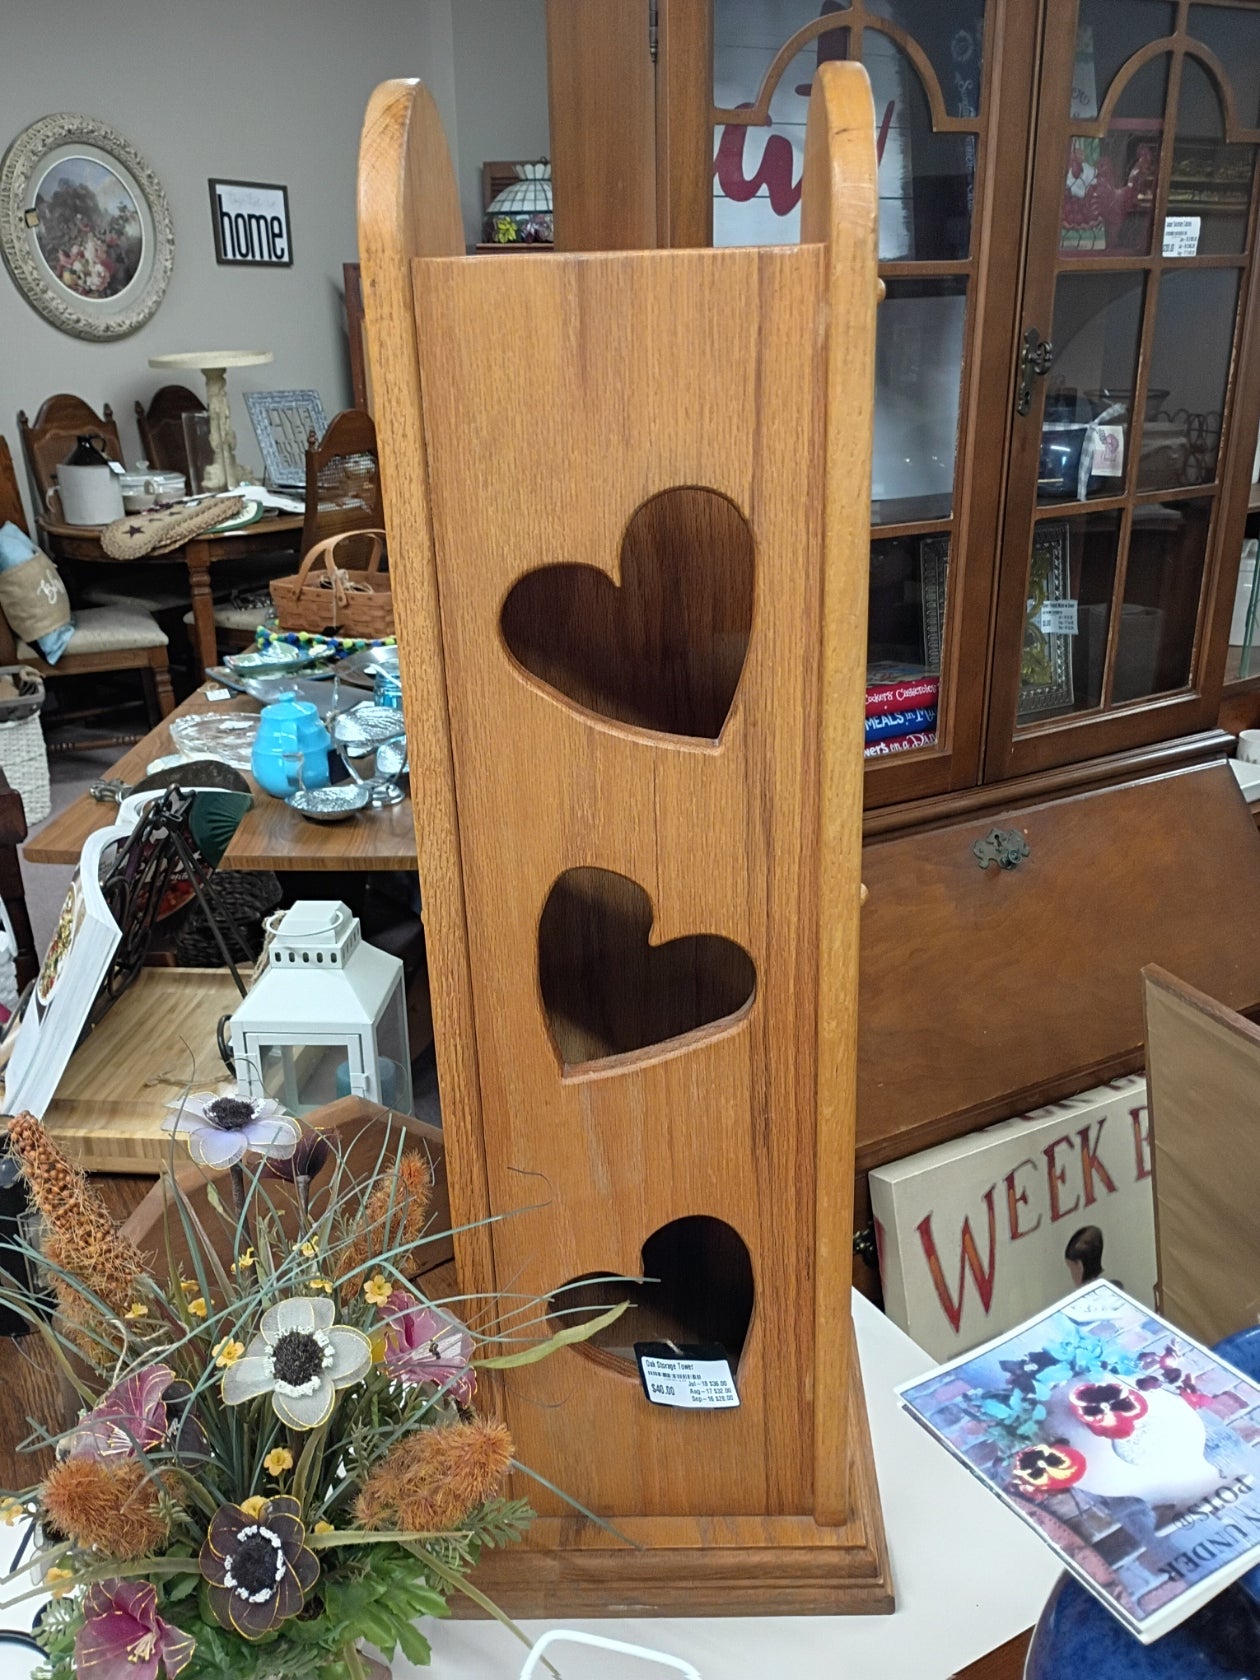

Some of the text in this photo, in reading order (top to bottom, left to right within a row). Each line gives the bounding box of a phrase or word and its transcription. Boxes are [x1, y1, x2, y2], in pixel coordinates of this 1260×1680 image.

[217, 193, 285, 260] home
[865, 711, 905, 731] MEALS
[914, 1115, 1118, 1334] WEEK
[656, 1361, 677, 1371] Storage
[677, 1363, 694, 1371] Tower
[651, 1383, 675, 1396] $40.00
[1157, 1523, 1248, 1582] UNDER
